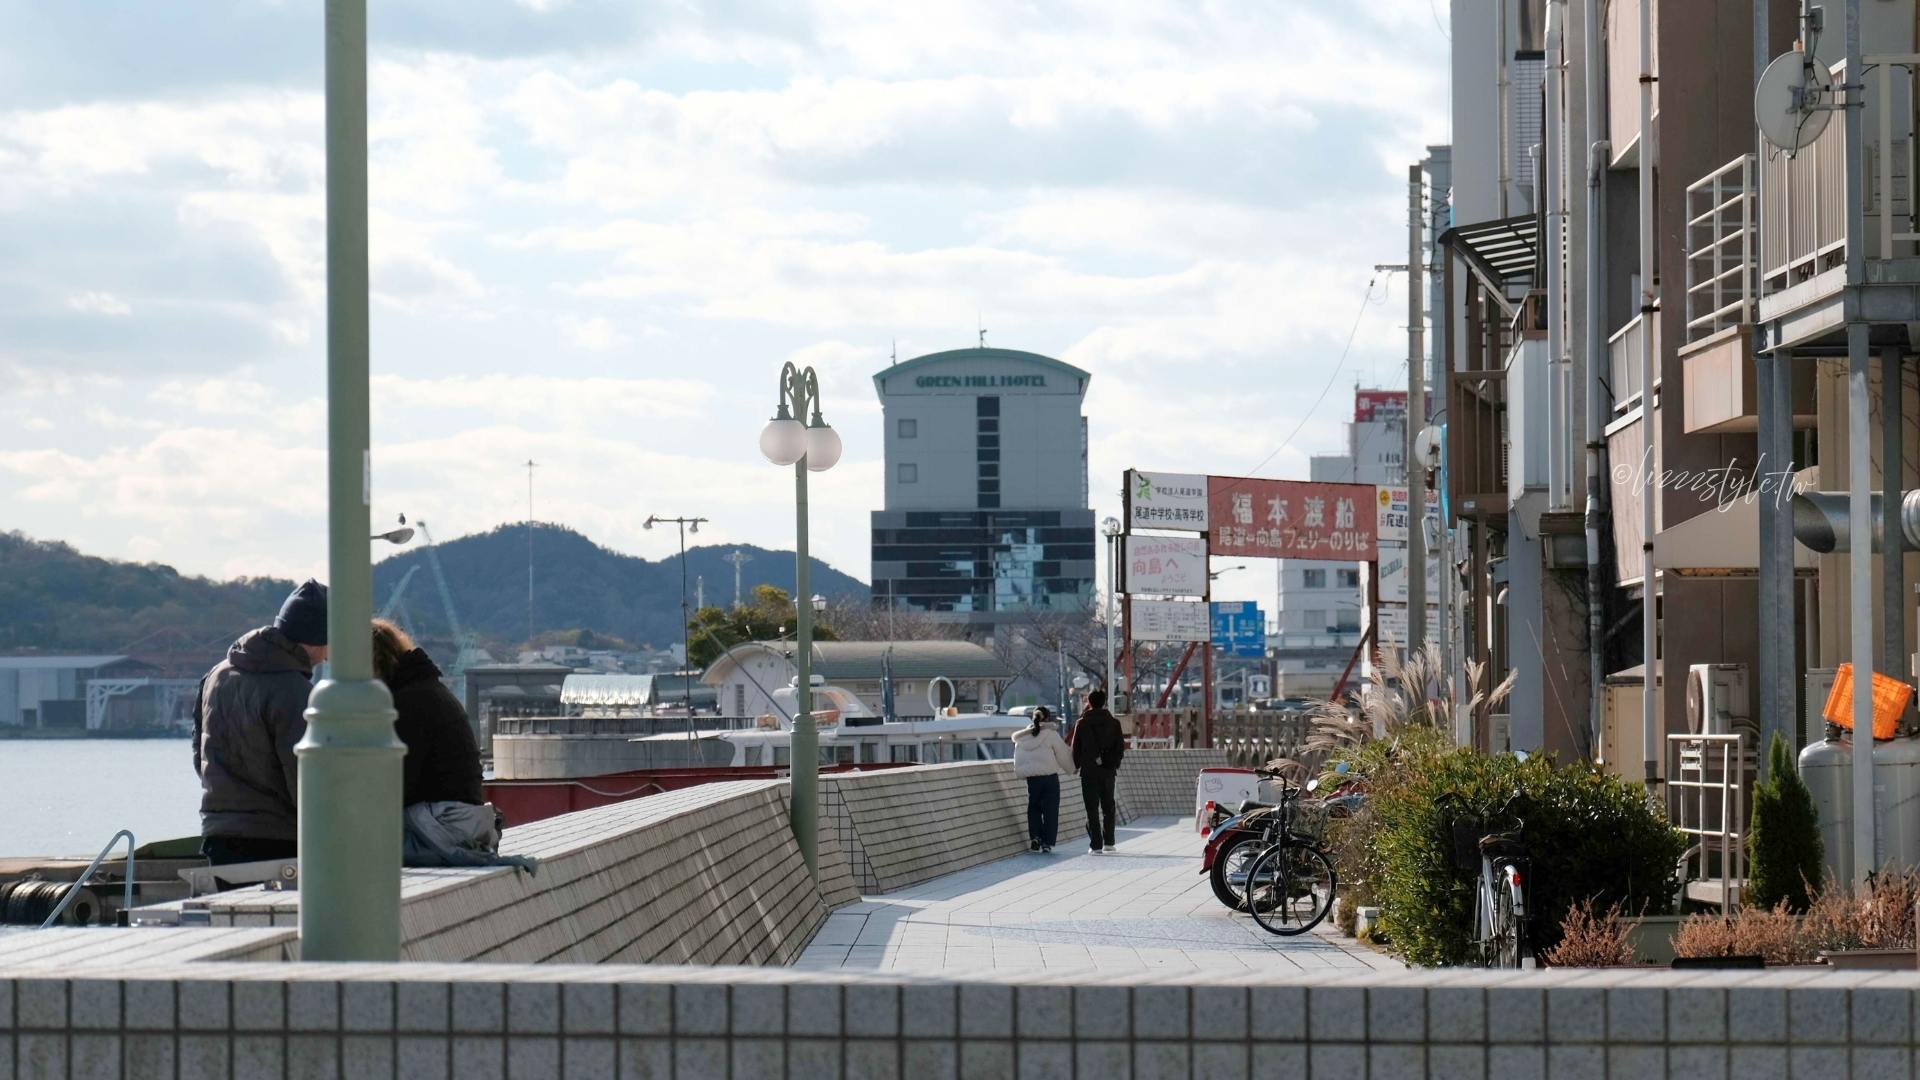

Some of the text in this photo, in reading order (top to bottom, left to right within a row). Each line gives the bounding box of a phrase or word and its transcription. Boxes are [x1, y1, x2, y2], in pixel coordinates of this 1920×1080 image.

[916, 375, 1047, 388] GREEN HILL HOTEL
[1231, 491, 1355, 529] 福本渡船
